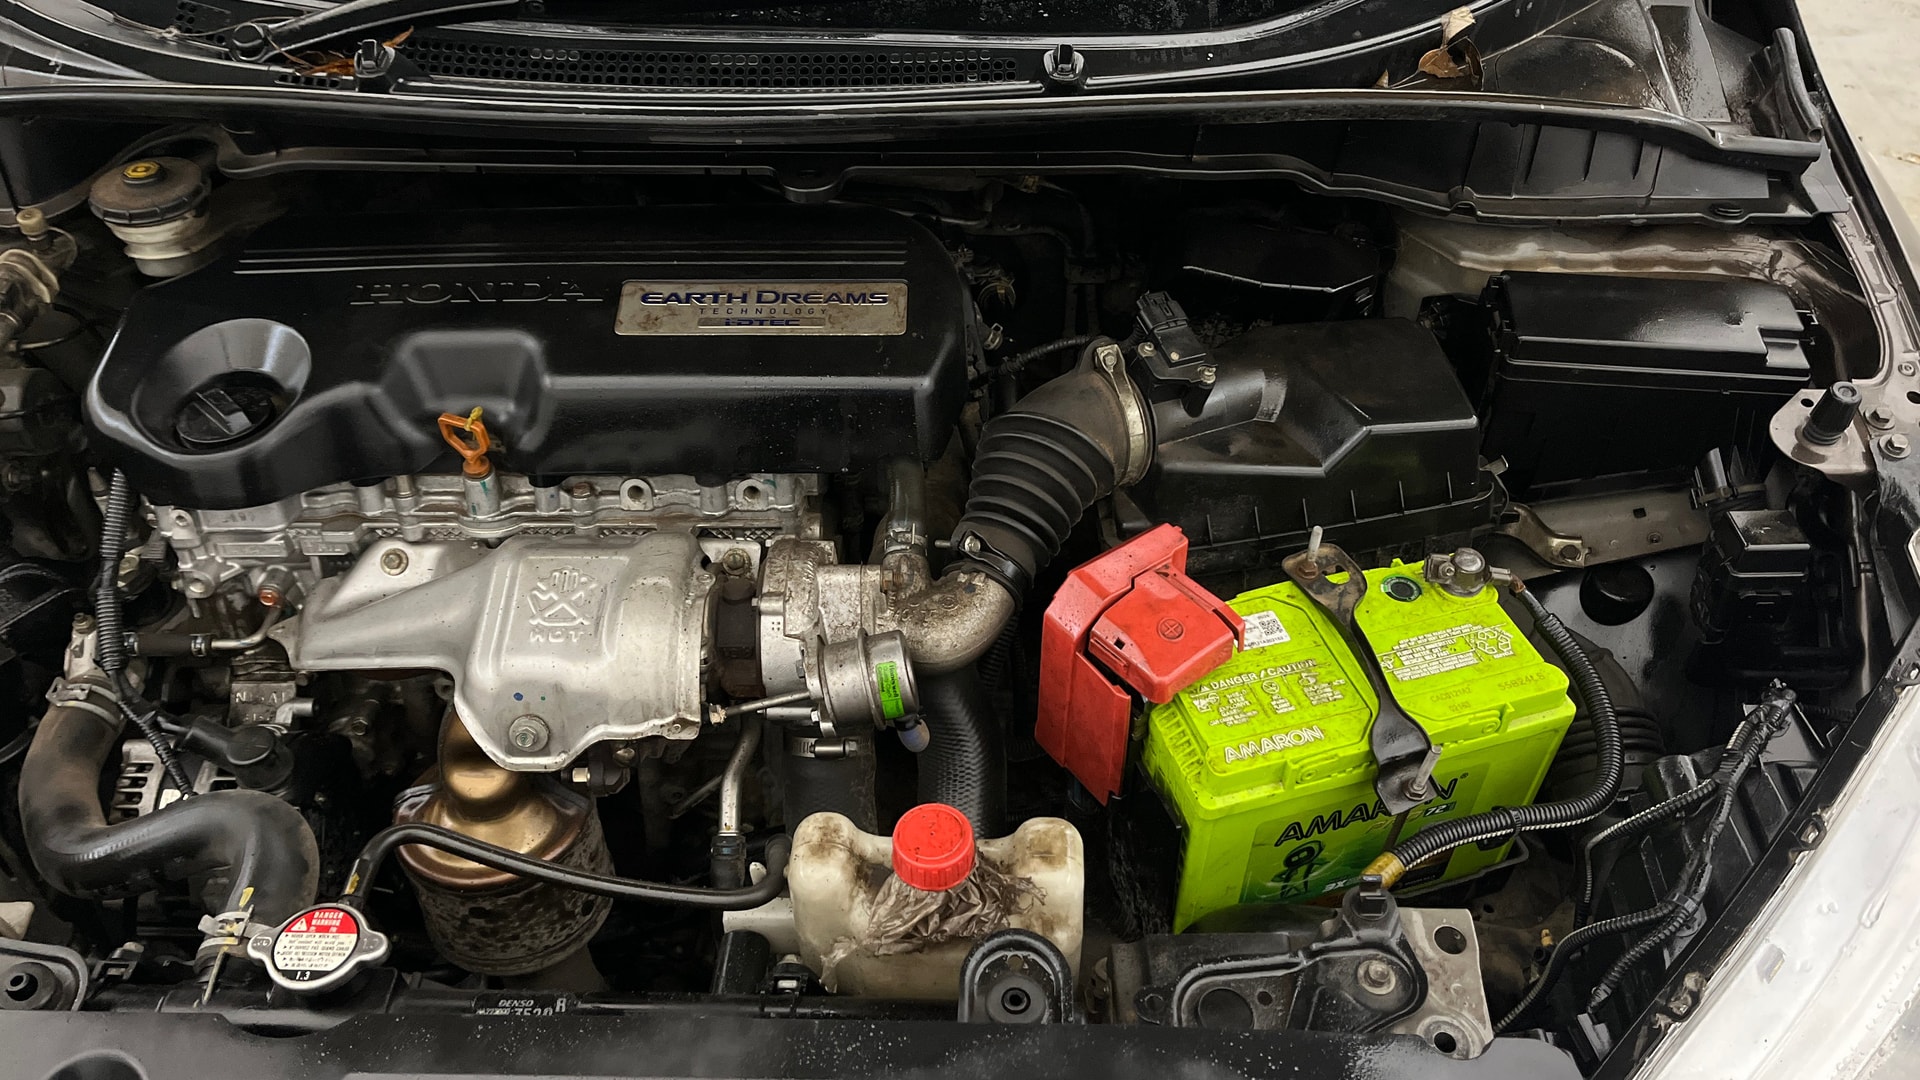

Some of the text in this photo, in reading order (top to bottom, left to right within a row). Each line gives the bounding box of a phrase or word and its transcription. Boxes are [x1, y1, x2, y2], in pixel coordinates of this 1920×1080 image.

[349, 280, 603, 305] HONDA
[640, 291, 747, 306] EARTH
[699, 307, 828, 315] TECHNOLOGY
[529, 630, 584, 643] HOT
[1210, 671, 1258, 690] DANGER
[1264, 659, 1316, 676] CAUTION
[1224, 725, 1324, 764] AMARON
[296, 971, 310, 980] 1.3
[498, 999, 534, 1007] DENSO
